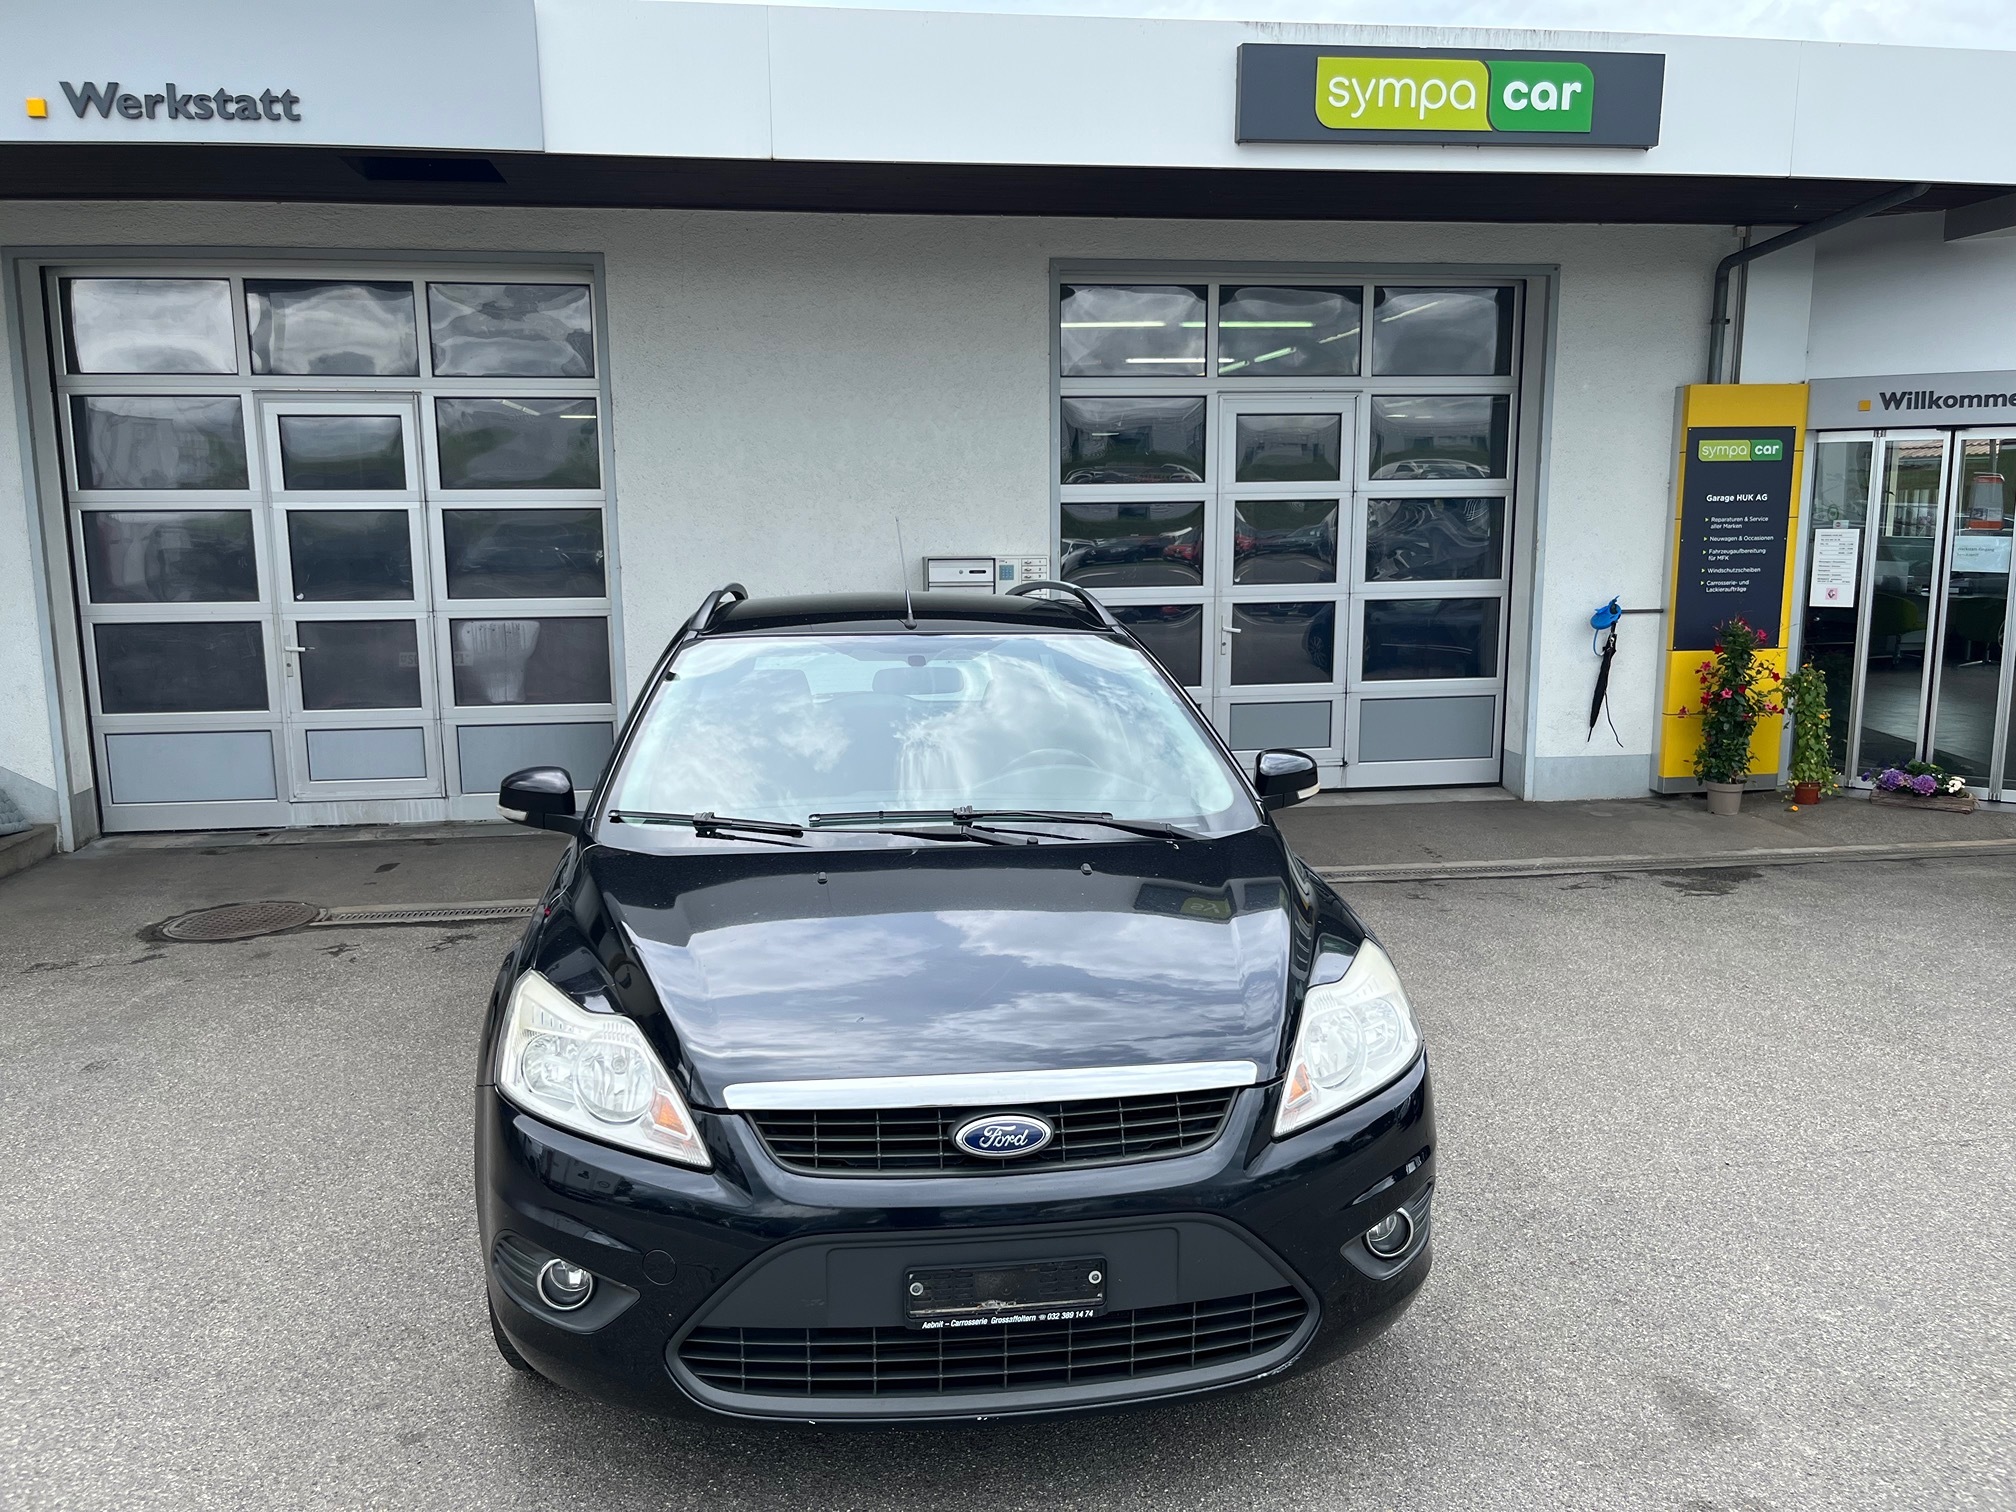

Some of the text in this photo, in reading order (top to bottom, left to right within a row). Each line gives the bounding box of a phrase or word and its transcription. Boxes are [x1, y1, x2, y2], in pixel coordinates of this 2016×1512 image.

[59, 81, 301, 121] Werkstatt
[1328, 77, 1582, 120] sympa car
[1879, 391, 2016, 411] Willkomme
[1702, 445, 1779, 458] sympa car
[1706, 494, 1735, 502] Garage
[1755, 493, 1768, 501] AG
[979, 1125, 1029, 1148] Ford
[950, 1317, 988, 1327] Carrosserie
[1046, 1312, 1060, 1321] 032
[1060, 1311, 1075, 1320] 389
[1075, 1310, 1084, 1318] 14
[1084, 1309, 1094, 1318] 74
